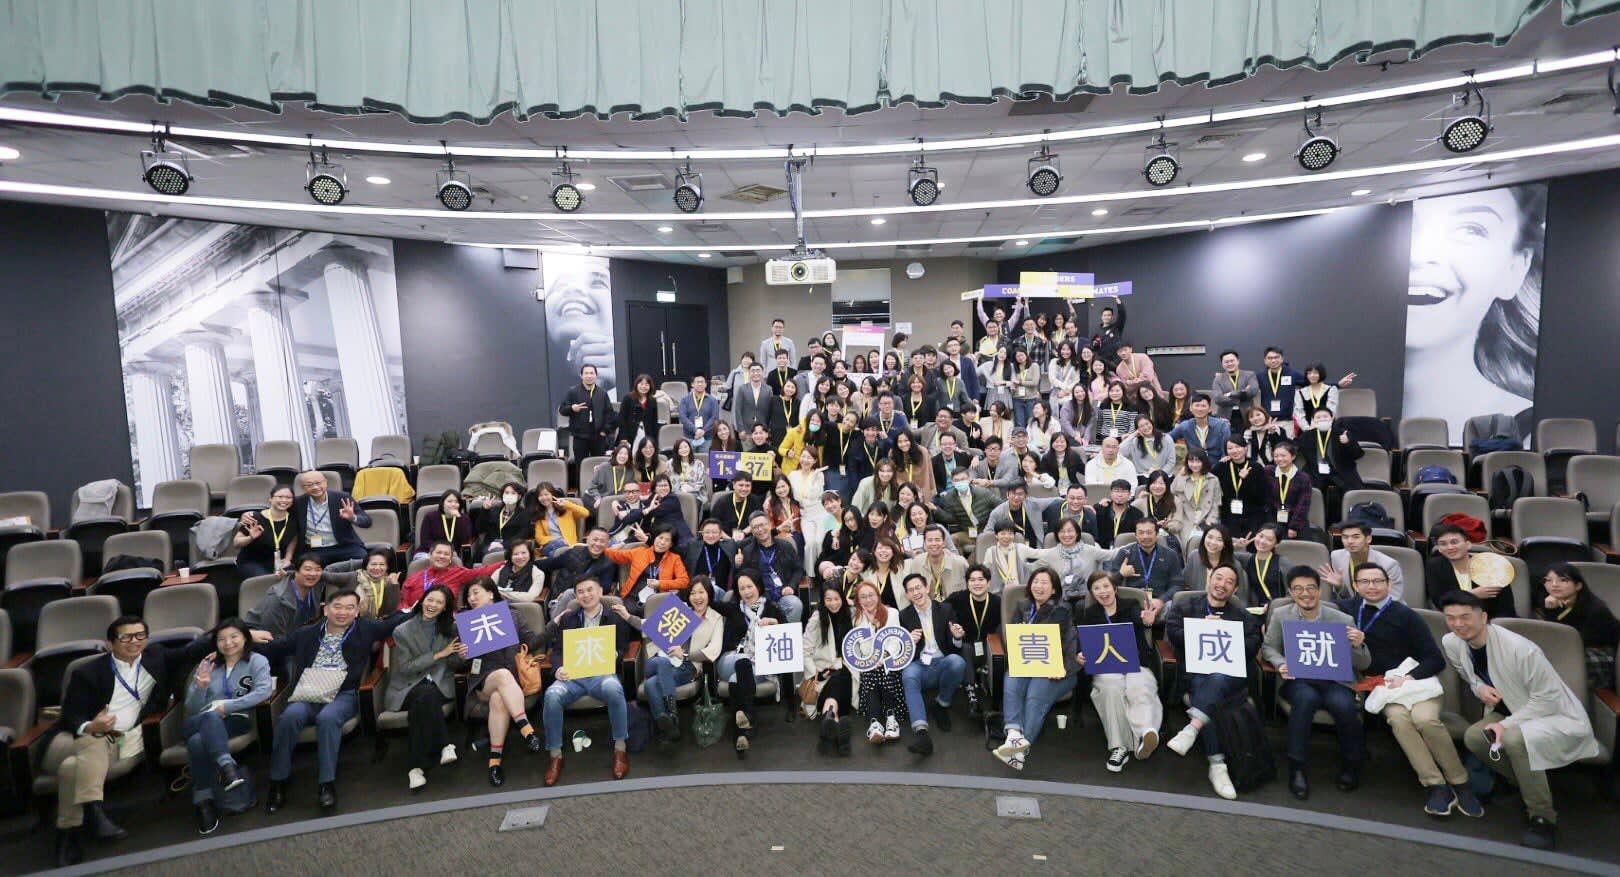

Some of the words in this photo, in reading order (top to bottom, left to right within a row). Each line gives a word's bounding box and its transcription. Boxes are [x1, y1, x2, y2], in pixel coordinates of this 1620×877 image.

[470, 613, 506, 644] 未
[656, 606, 688, 643] 領
[575, 636, 606, 667] 來
[765, 633, 794, 663] 袖
[1018, 632, 1051, 665] 貴
[1095, 633, 1128, 664] 人
[1198, 629, 1233, 664] 成
[1296, 630, 1338, 668] 就
[236, 675, 253, 697] S
